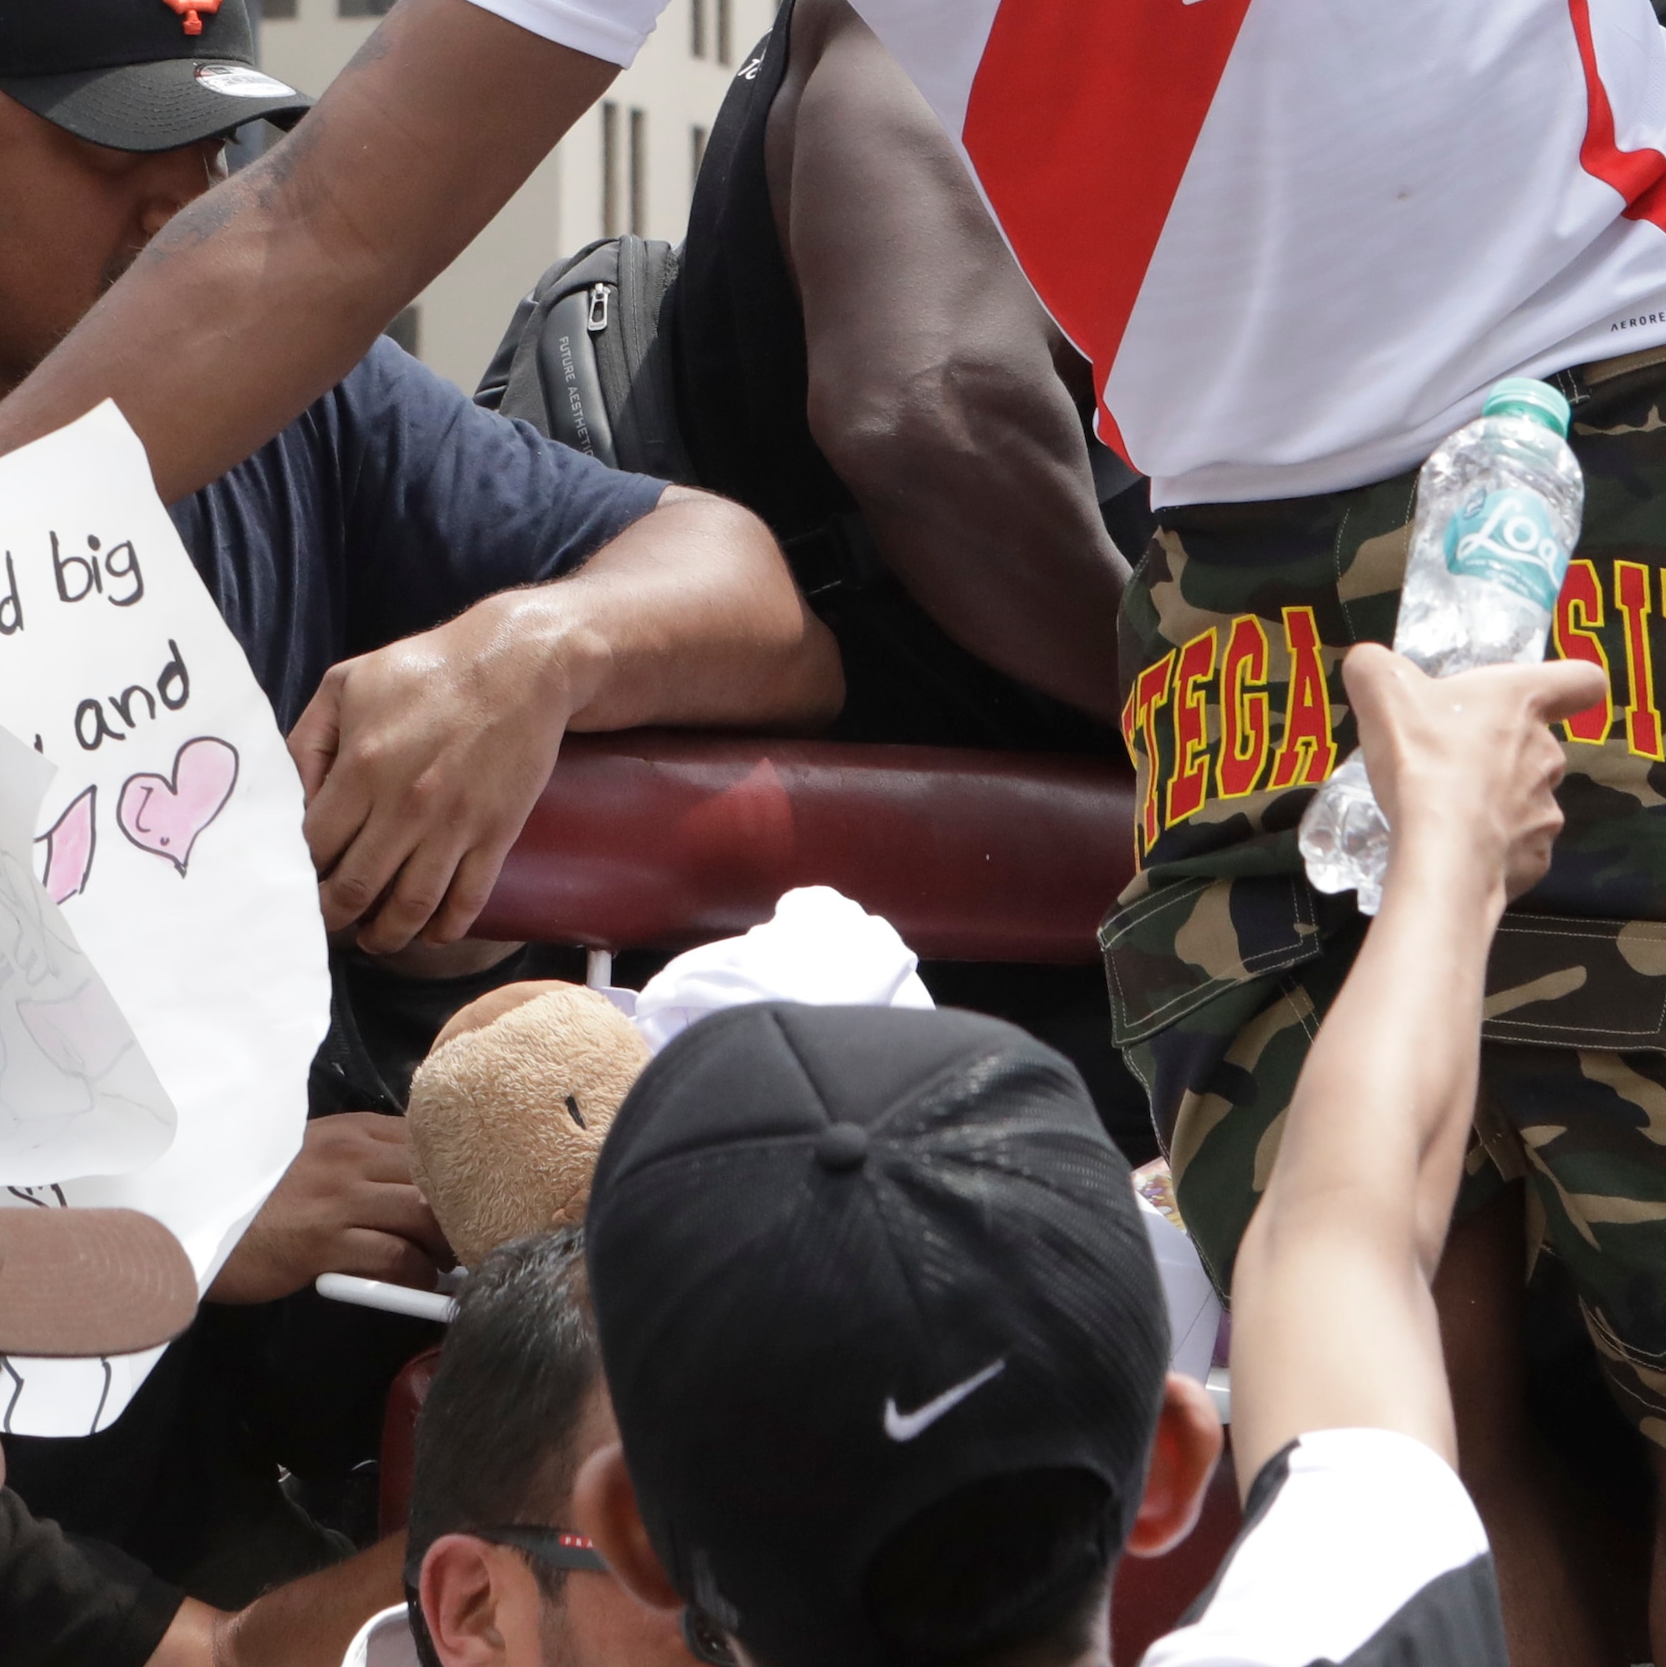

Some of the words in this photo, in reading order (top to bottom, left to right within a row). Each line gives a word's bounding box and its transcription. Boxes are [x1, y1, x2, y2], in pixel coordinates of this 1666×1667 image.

[559, 336, 576, 383] FUTURE
[49, 530, 144, 607] big
[74, 638, 190, 751] and
[1122, 606, 1337, 873] TEGA
[564, 1536, 593, 1549] PRA
